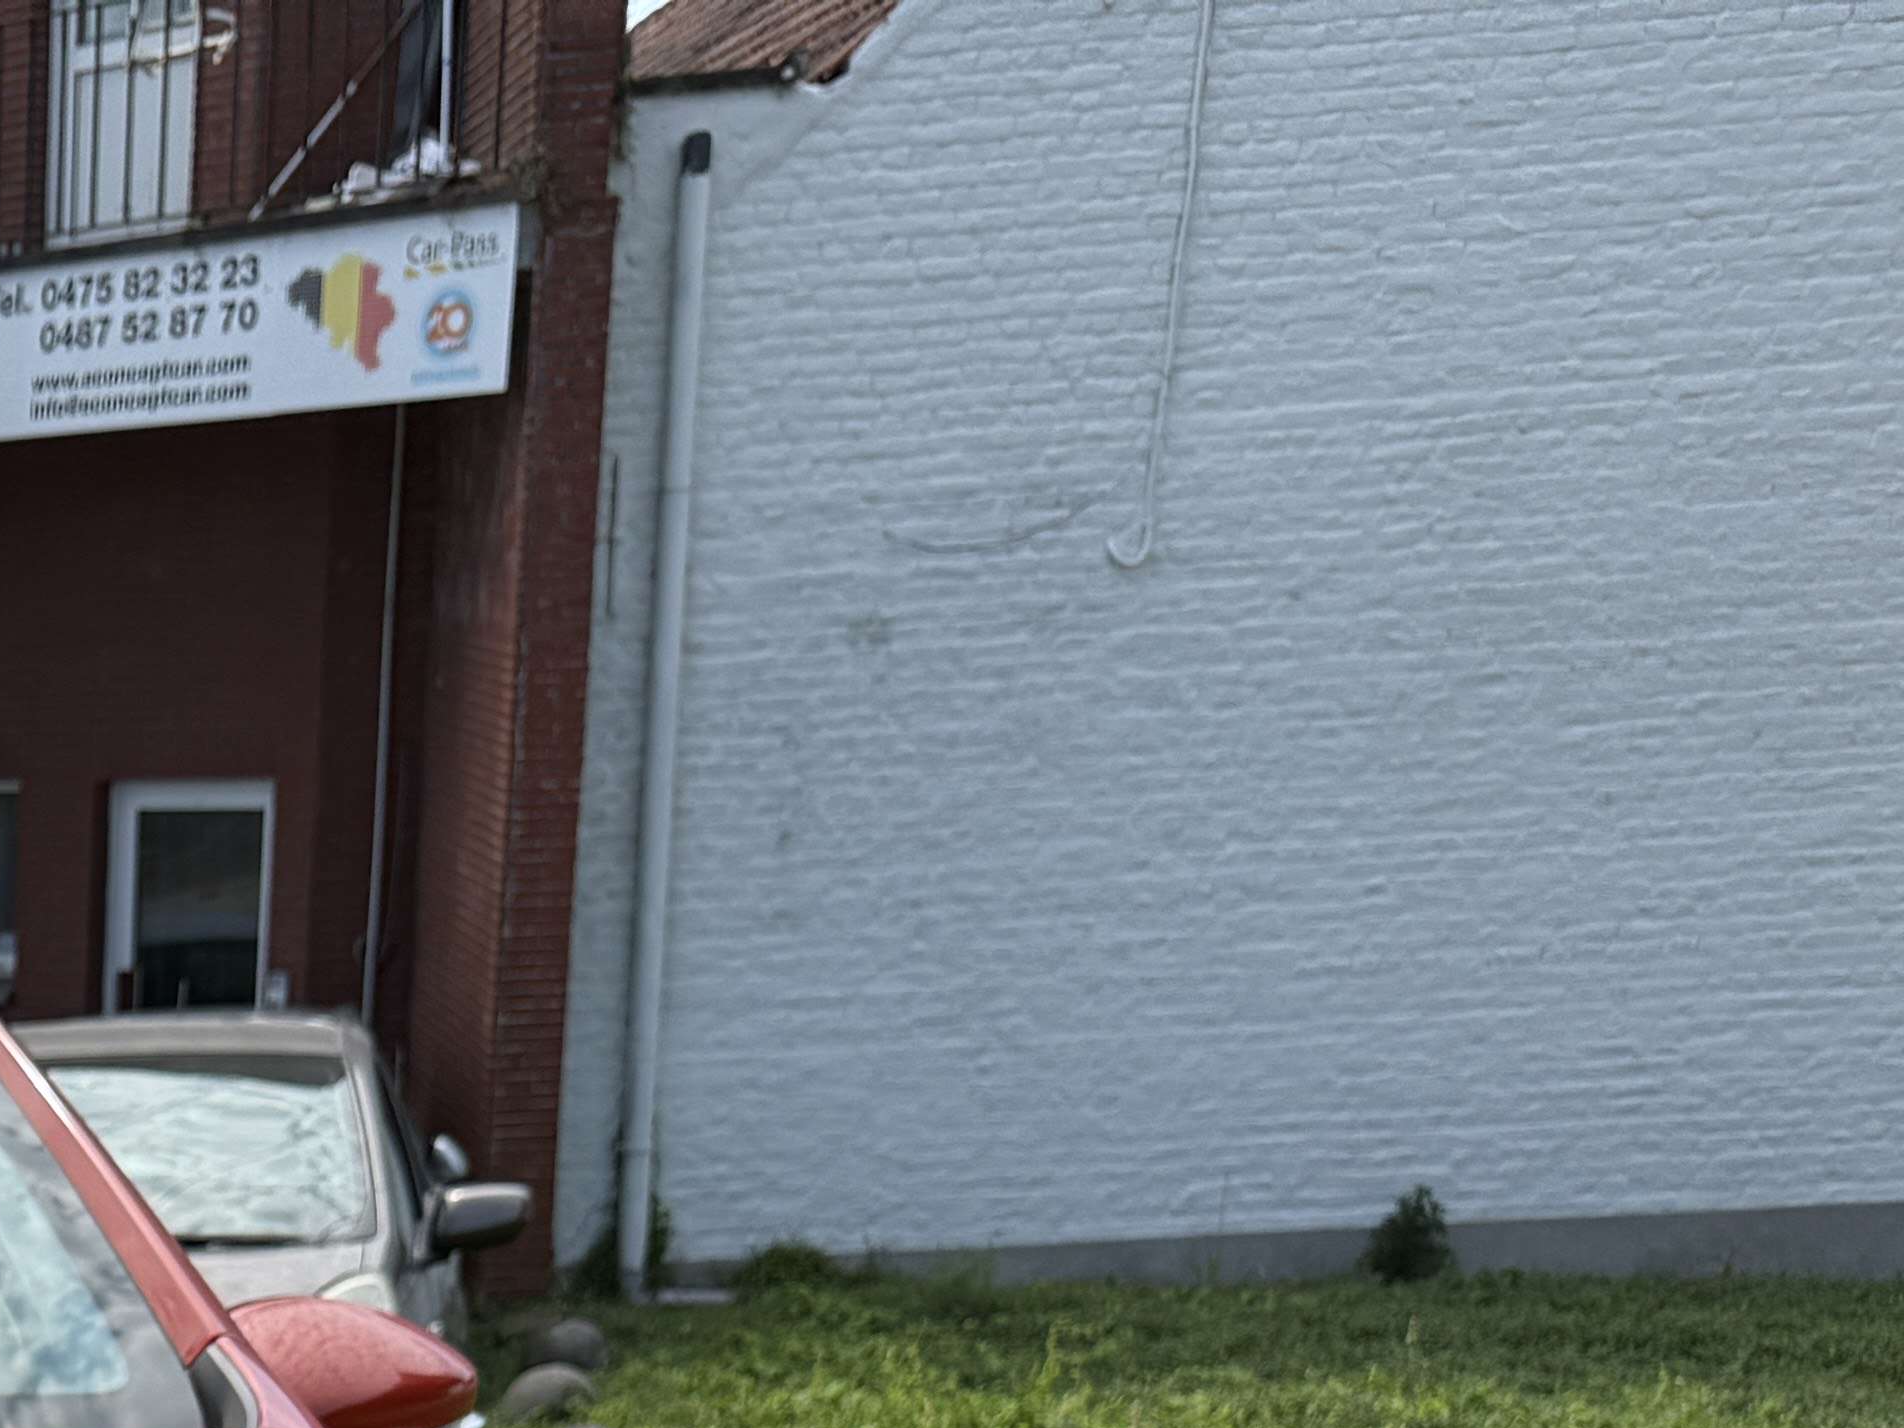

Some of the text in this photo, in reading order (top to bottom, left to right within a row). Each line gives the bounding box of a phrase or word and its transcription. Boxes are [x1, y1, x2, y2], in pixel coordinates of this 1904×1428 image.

[42, 271, 113, 311] 0475
[122, 265, 161, 302] 82
[171, 260, 209, 296] 32
[221, 253, 260, 290] 23
[39, 299, 259, 353] 0487 52 87 70
